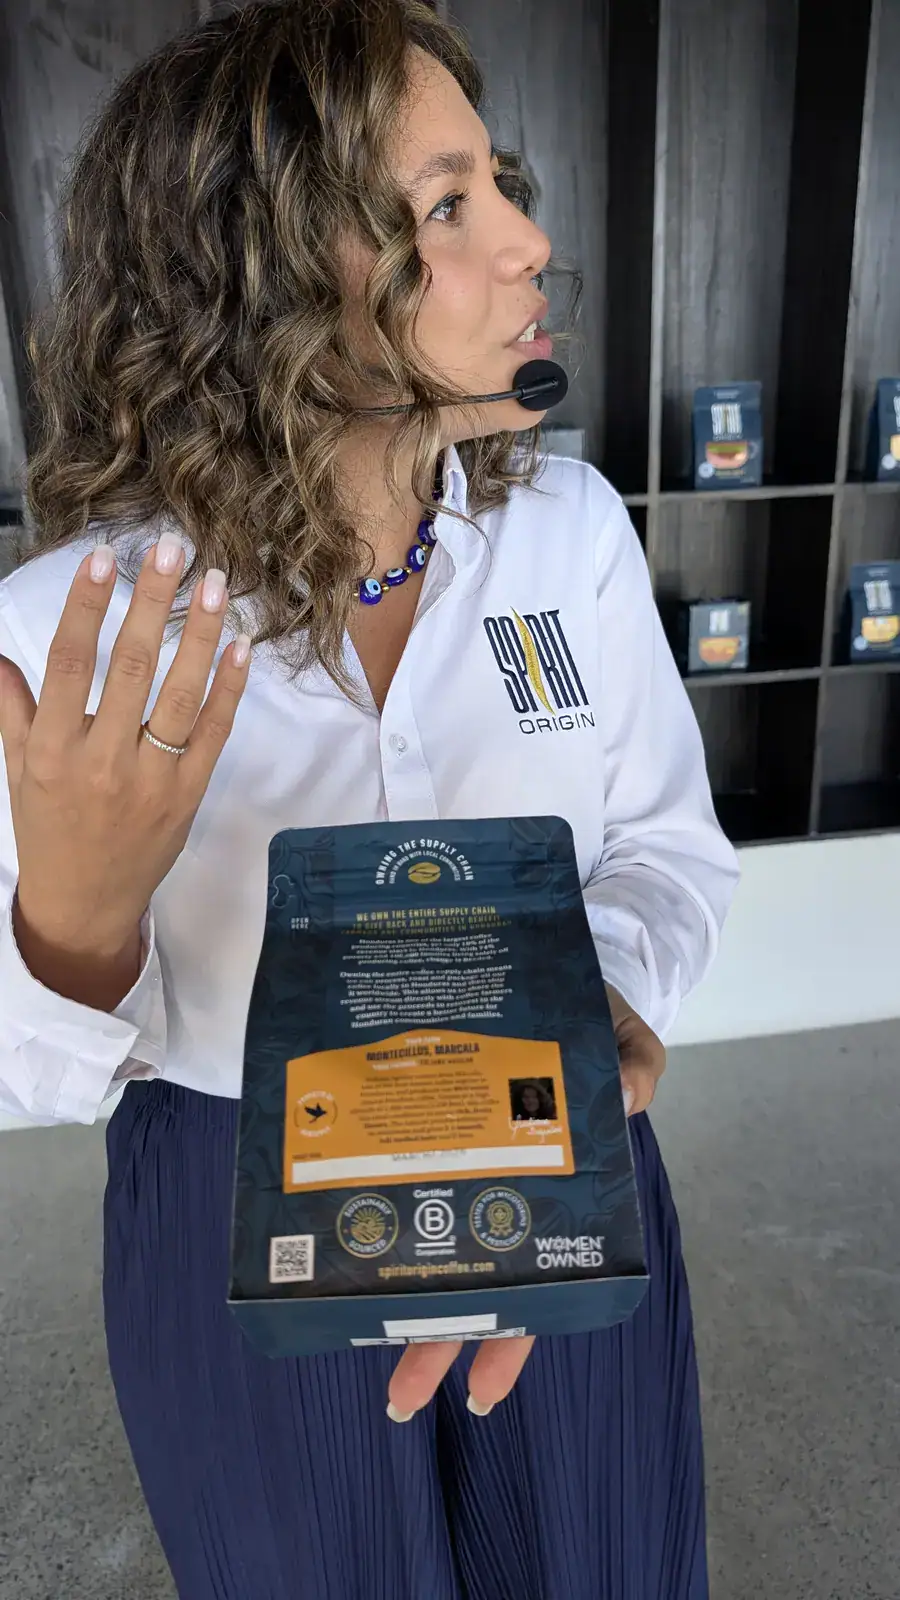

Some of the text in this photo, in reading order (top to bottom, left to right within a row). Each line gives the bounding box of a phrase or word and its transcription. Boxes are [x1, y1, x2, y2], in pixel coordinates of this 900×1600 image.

[483, 606, 590, 715] SPIRIT
[518, 712, 595, 735] ORIGIN
[375, 838, 474, 885] OWNING THE SUPPLY CHAIN
[422, 850, 439, 859] LOCAL
[356, 905, 496, 921] WE OWN THE ENTIRE SUPPLY CHAIN
[386, 919, 406, 929] BACK
[410, 918, 426, 927] AND
[429, 917, 465, 926] DIRECTLY
[463, 967, 485, 975] chain
[486, 965, 512, 973] means
[350, 1018, 393, 1028] Honduran
[467, 1011, 503, 1019] families.
[355, 1010, 388, 1020] country
[366, 1043, 480, 1061] MONTECILLOS, MARCALA
[413, 1188, 454, 1199] Certified
[482, 1192, 496, 1203] FOR
[344, 1198, 393, 1218] SUSTAINABLY
[424, 1206, 445, 1232] B
[348, 1239, 387, 1253] SOURCED
[534, 1236, 603, 1252] WOMEN
[536, 1251, 604, 1270] OWNED
[378, 1261, 495, 1280] spiritorigincoffee.com
